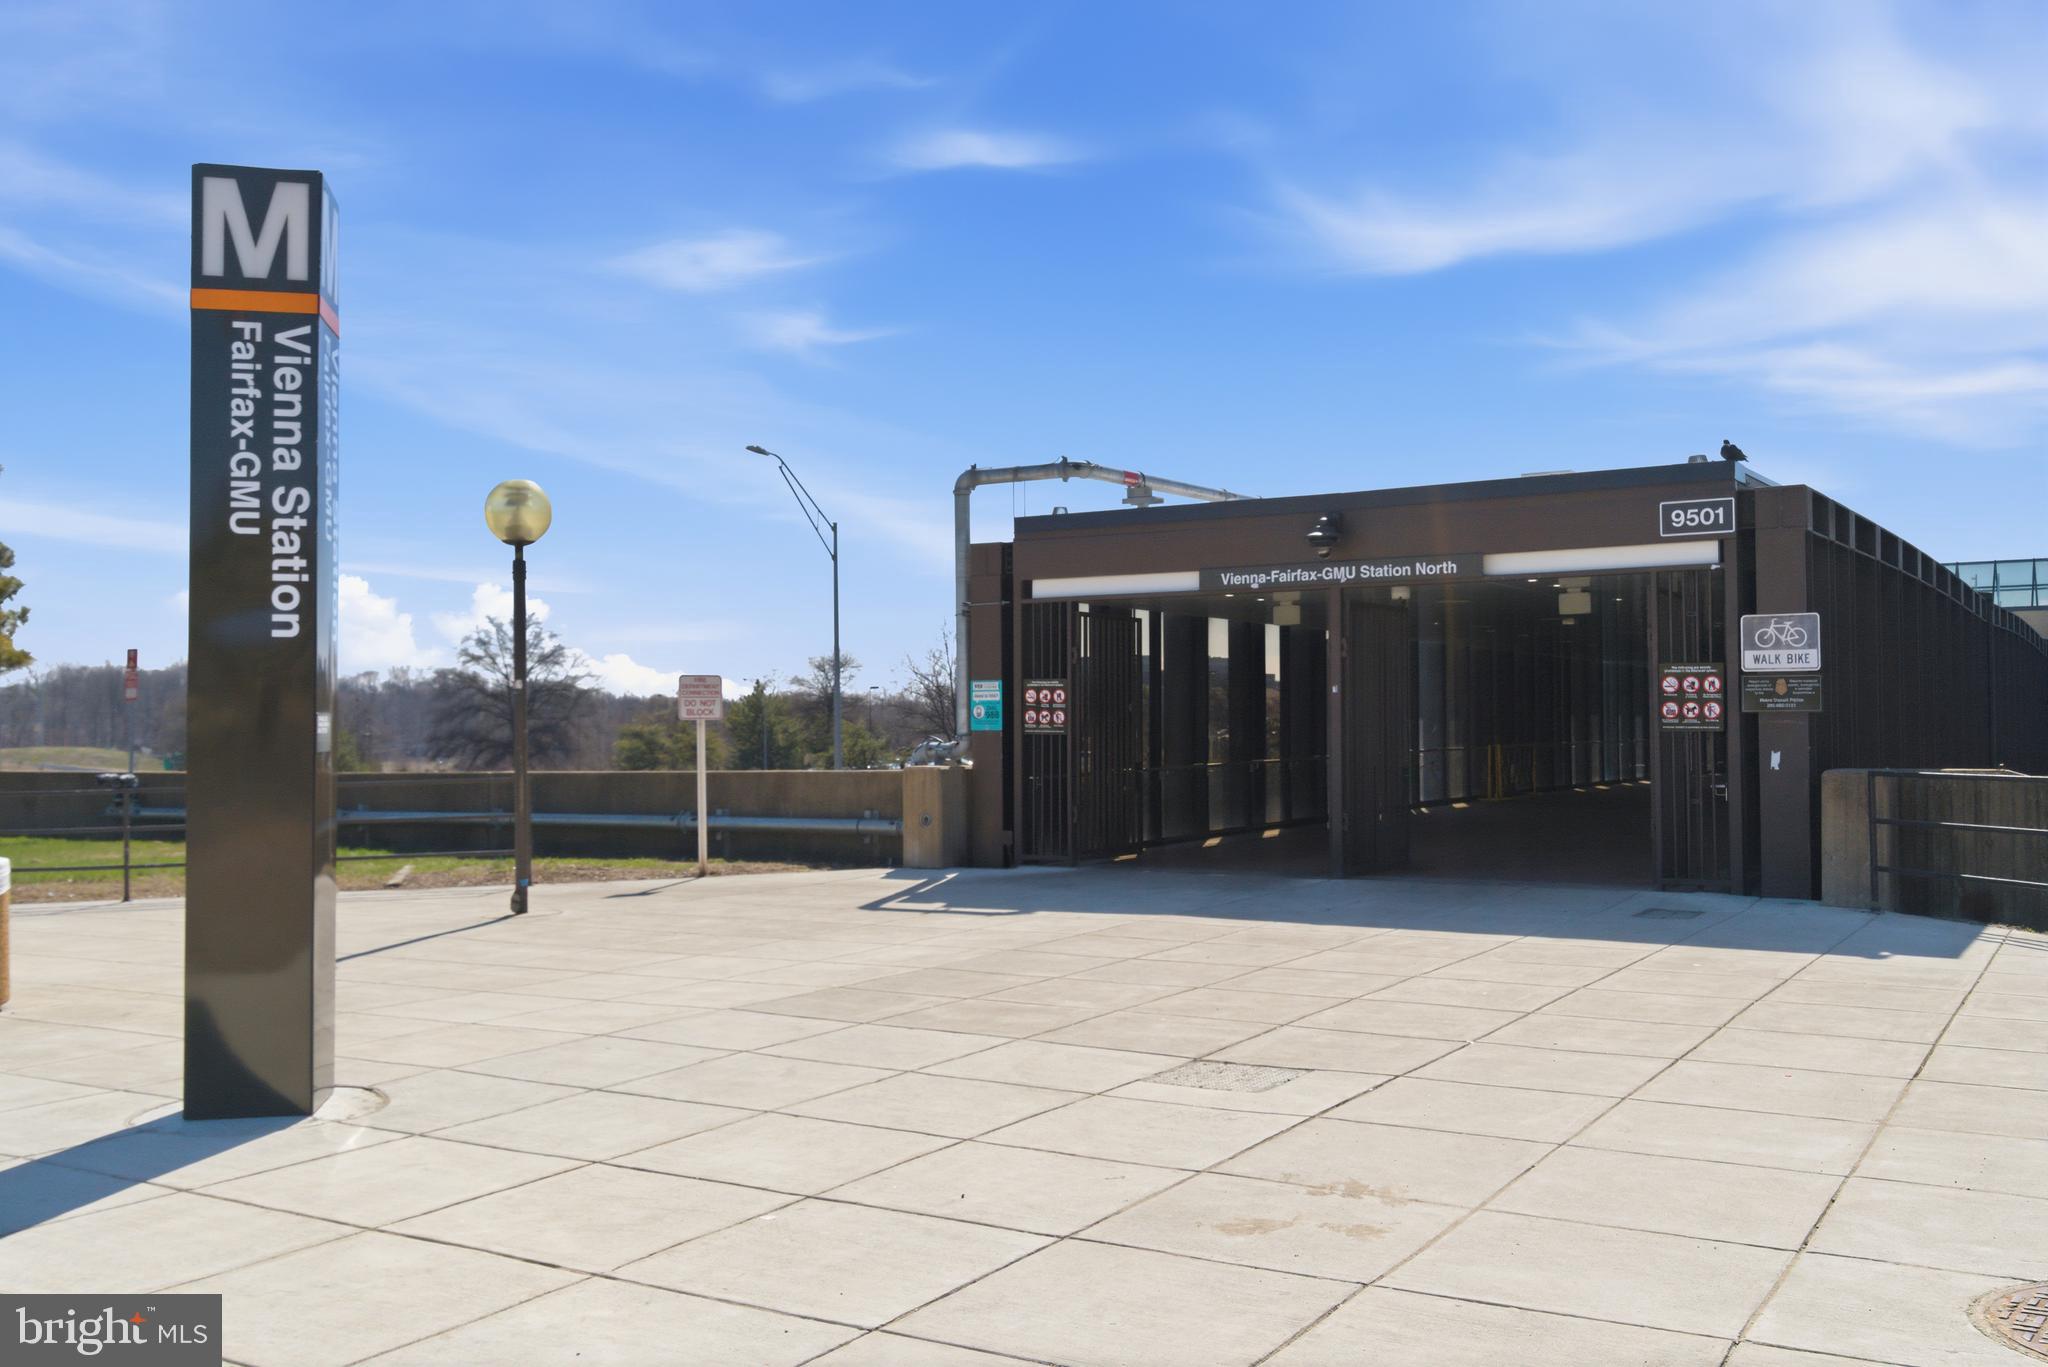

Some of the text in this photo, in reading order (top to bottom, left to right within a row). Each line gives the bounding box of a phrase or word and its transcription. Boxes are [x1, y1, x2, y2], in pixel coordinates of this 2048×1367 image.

[202, 176, 309, 281] M
[229, 321, 262, 535] Fairfax-GMU
[271, 325, 311, 638] Vienna Station
[1671, 507, 1724, 527] 9501
[1221, 561, 1457, 586] Vienna-Fairfax-GMU Station North
[1753, 653, 1811, 664] WALK BIKE
[684, 699, 716, 707] DO NOT
[686, 708, 714, 716] BLOCK
